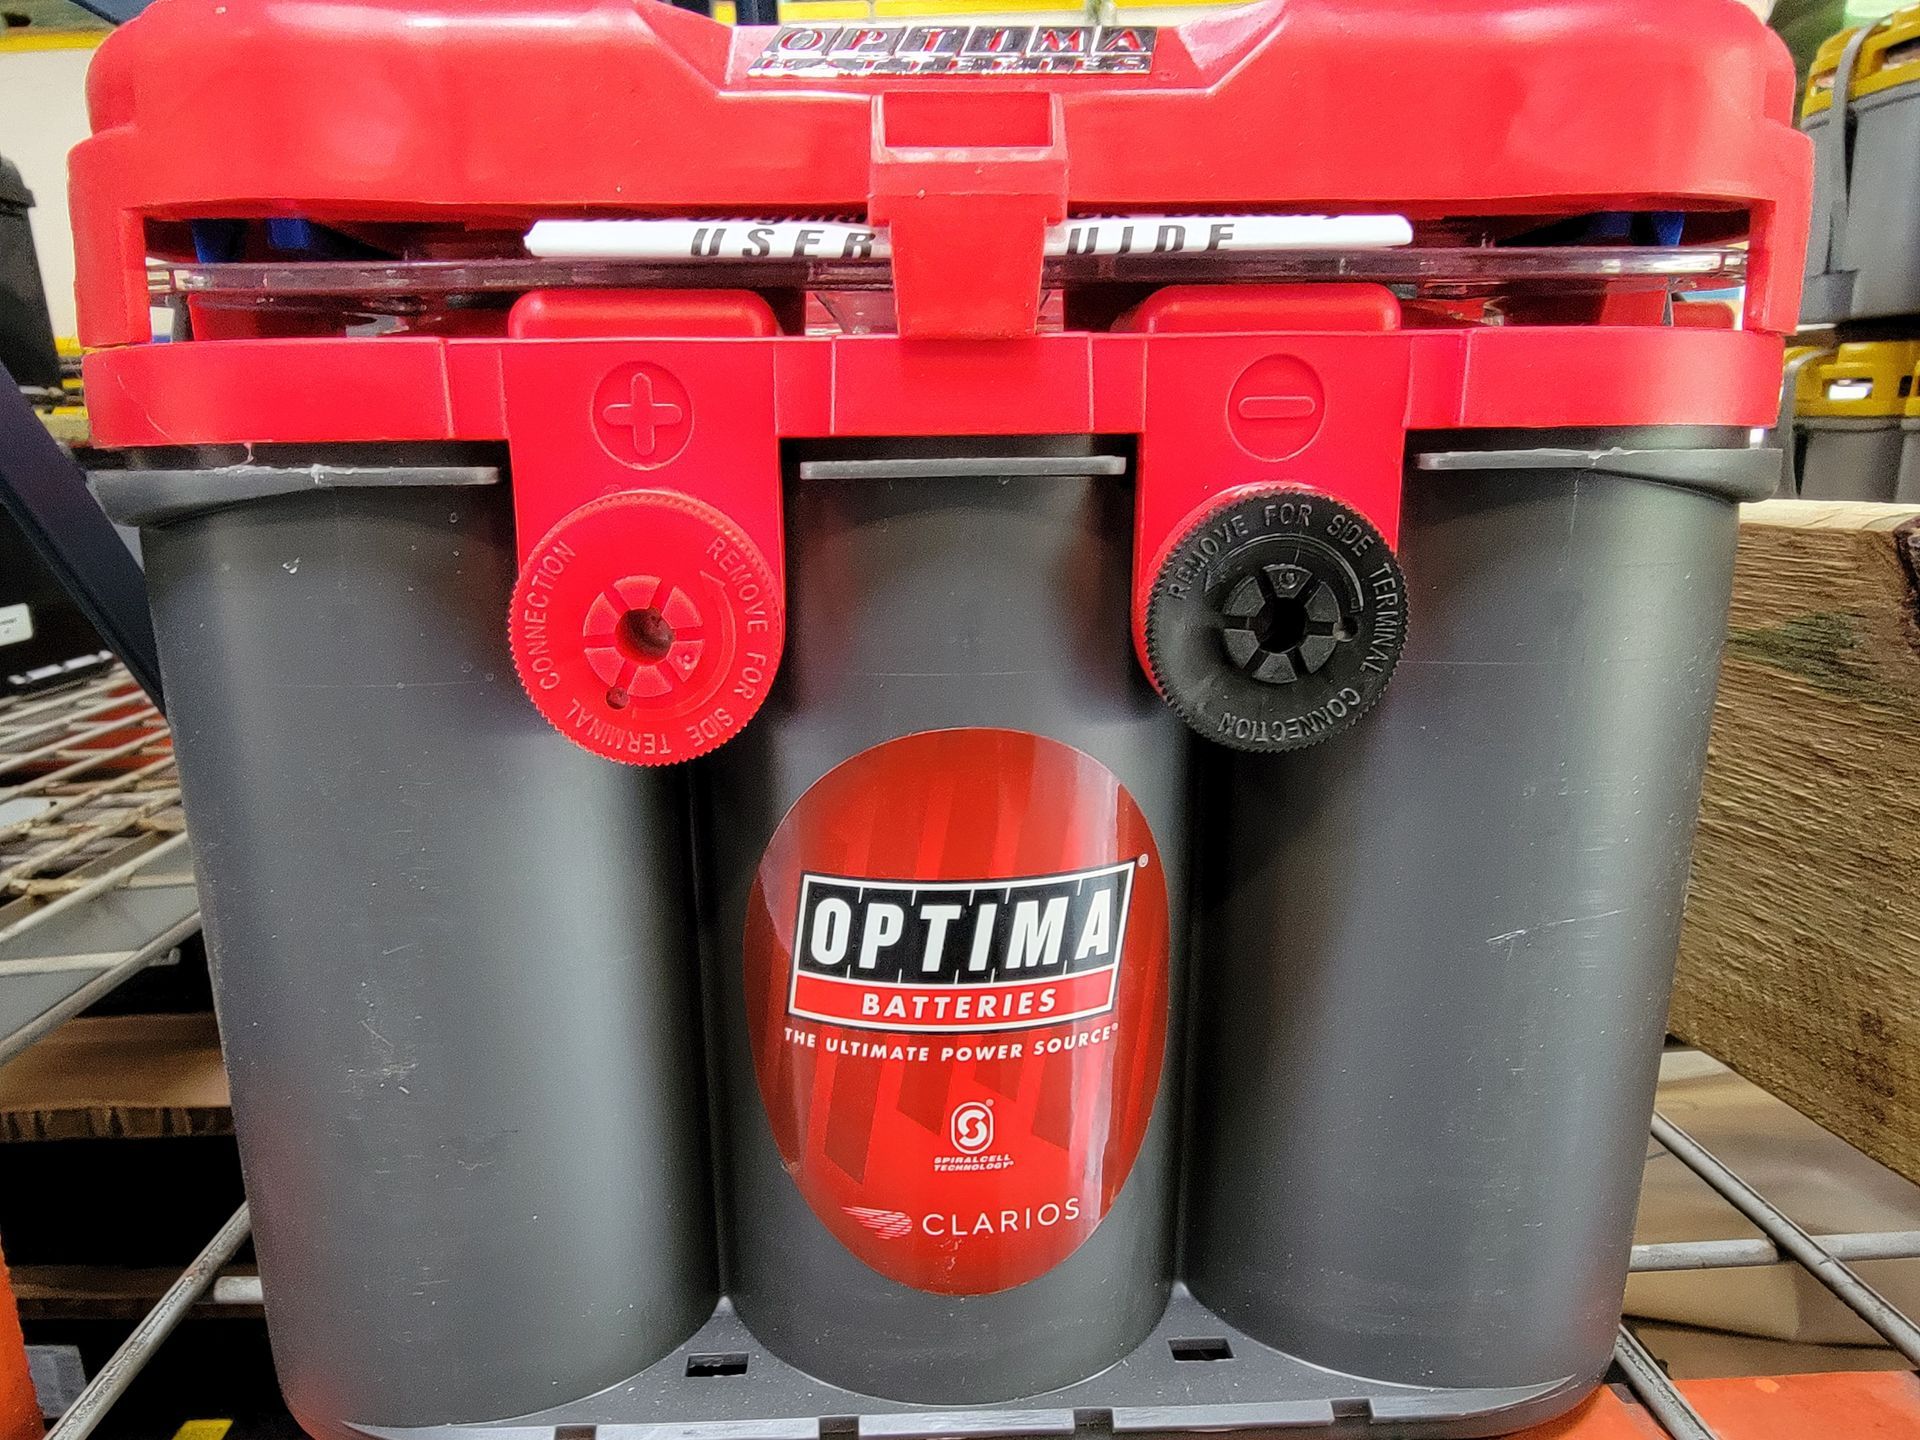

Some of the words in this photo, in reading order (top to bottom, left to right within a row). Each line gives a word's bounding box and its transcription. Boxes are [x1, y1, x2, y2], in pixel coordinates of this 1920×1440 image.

[778, 28, 1146, 52] OPTIMA
[691, 227, 877, 259] USER
[1065, 223, 1236, 256] UIDE
[1264, 502, 1313, 527] FOR
[1326, 513, 1375, 557] SIDE
[1167, 514, 1249, 600] REMOVE
[705, 536, 768, 634] REMOVE
[524, 540, 577, 690] CONNECTION
[1359, 562, 1400, 673] TERMINAL
[733, 651, 767, 700] FOR
[565, 697, 672, 755] TERMINAL
[686, 707, 734, 748] SIDE
[1217, 687, 1361, 742] CONNECTION
[810, 888, 1112, 973] OPTIMA
[862, 988, 1057, 1020] BATTERIES
[784, 1027, 817, 1048] THE
[825, 1038, 929, 1062] ULTIMATE
[940, 1043, 1023, 1062] POWER
[934, 1154, 1011, 1164] SPIRALCELL
[922, 1197, 1081, 1236] CLARIOS
